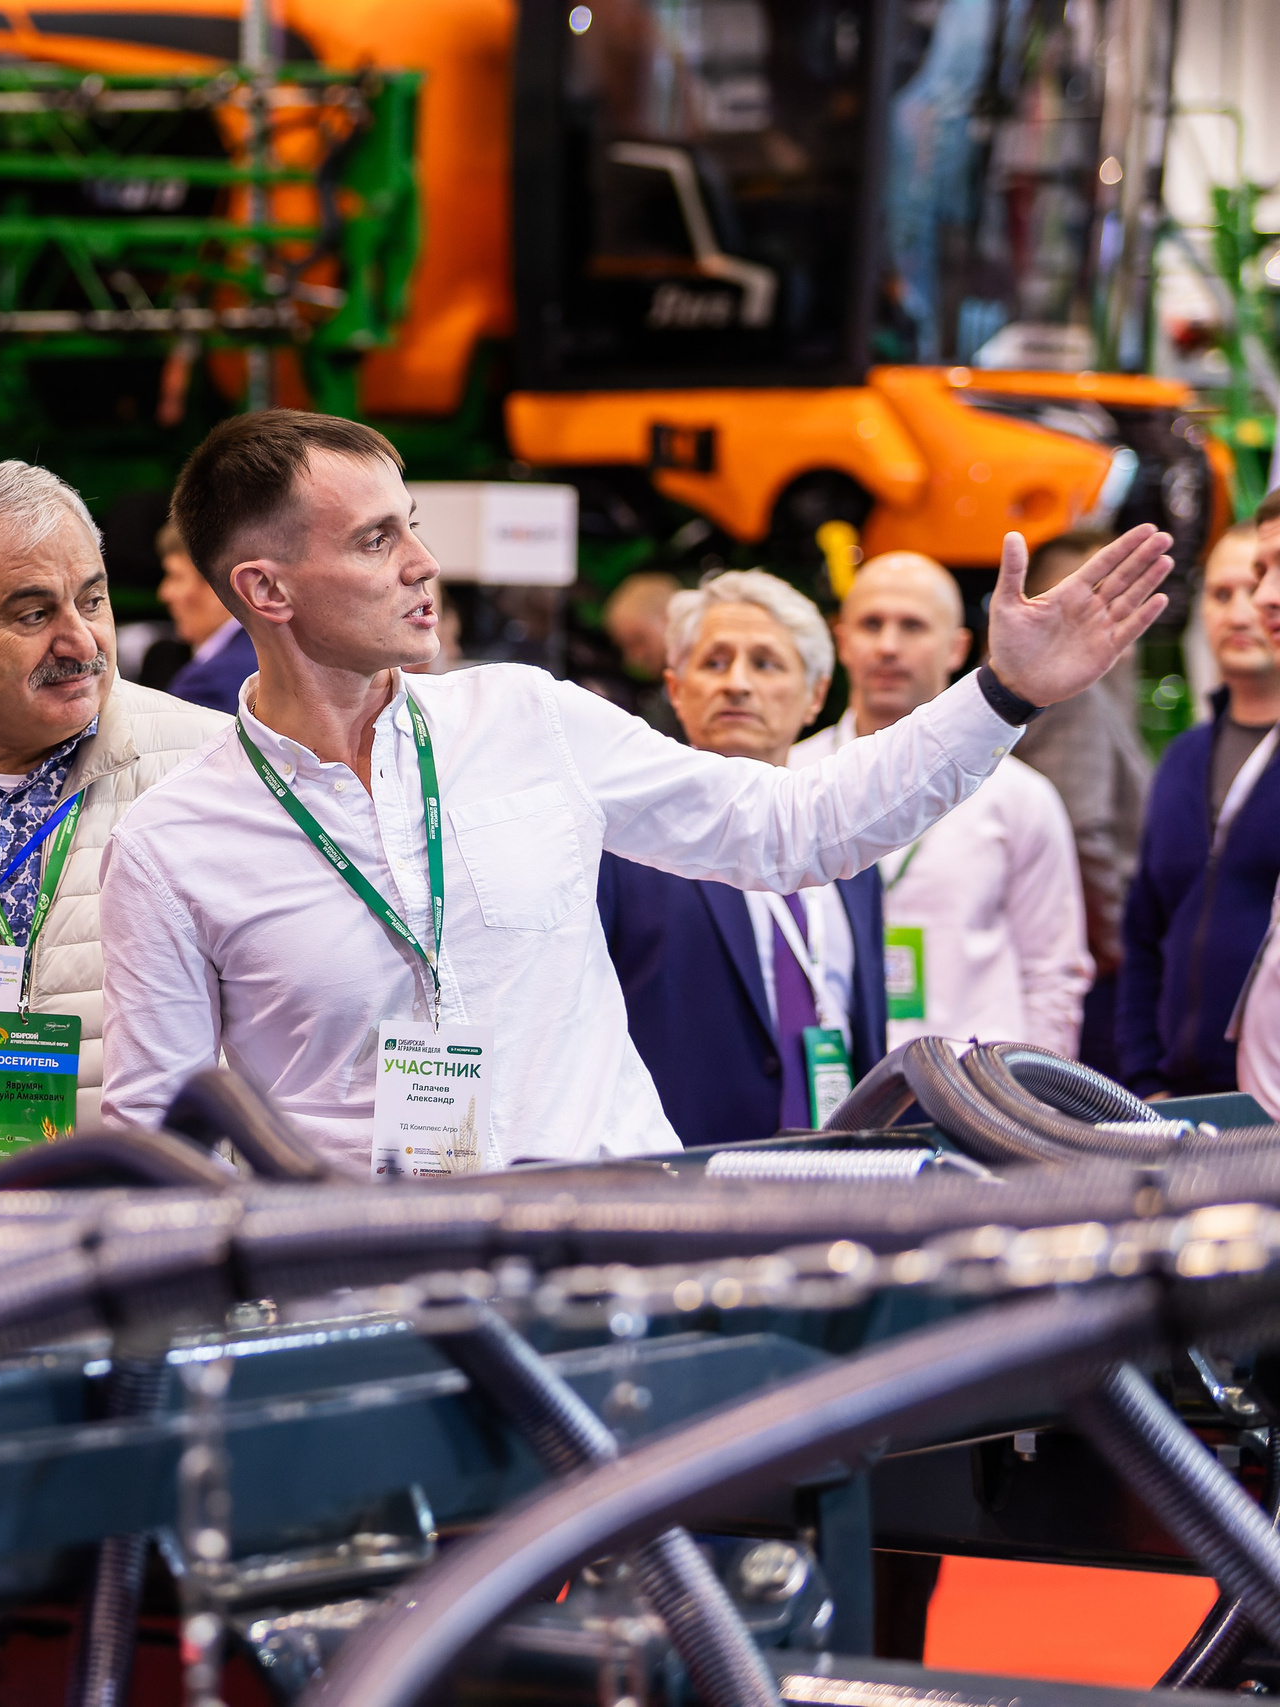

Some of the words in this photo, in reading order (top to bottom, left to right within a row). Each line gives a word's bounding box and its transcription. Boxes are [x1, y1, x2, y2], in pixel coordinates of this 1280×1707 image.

[397, 1039, 425, 1047] СИБИРСКАЯ
[397, 1045, 422, 1053] АГРАРНАЯ
[421, 1046, 441, 1054] НЕДЕЛЯ
[384, 1059, 482, 1079] УЧАСТНИК
[6, 1081, 43, 1091] Яврумян
[412, 1083, 450, 1092] Палачев
[16, 1091, 65, 1101] Амаякович
[406, 1094, 455, 1105] Александр
[410, 1123, 441, 1131] Комплекс
[442, 1125, 458, 1133] Агро
